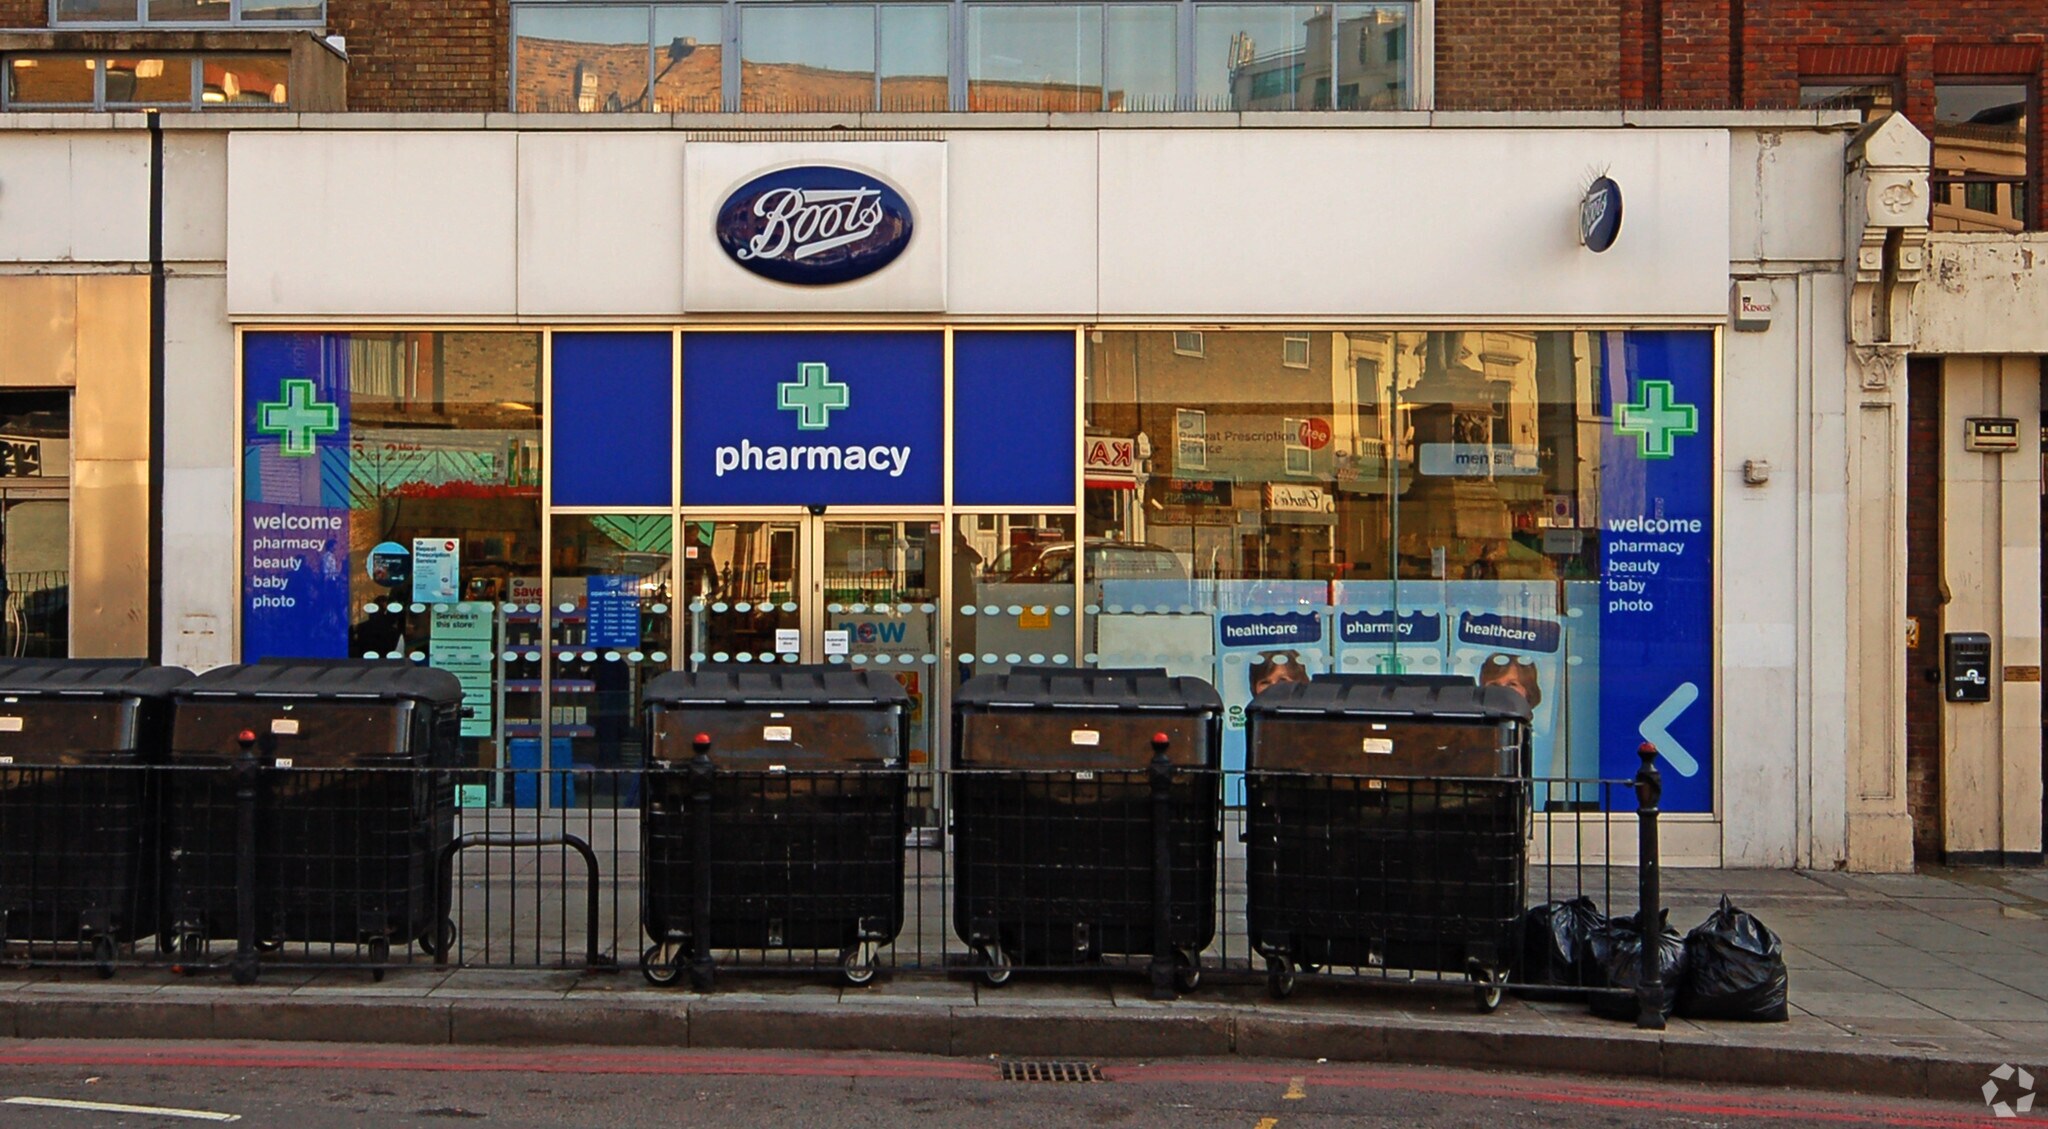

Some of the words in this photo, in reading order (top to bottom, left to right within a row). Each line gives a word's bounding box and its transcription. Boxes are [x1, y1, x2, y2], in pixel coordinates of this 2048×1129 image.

[737, 187, 883, 260] Boots
[1225, 431, 1296, 443] Prescription
[1300, 424, 1327, 442] free
[715, 439, 911, 477] pharmacy
[252, 512, 342, 530] welcome
[1608, 514, 1702, 533] welcome
[253, 536, 326, 552] pharmacy
[1609, 539, 1685, 555] pharmacy
[253, 555, 302, 572] beauty
[1609, 558, 1660, 575] beauty
[253, 575, 289, 591] baby
[1609, 578, 1646, 594] baby
[513, 587, 543, 597] save
[253, 594, 296, 610] photo
[1609, 598, 1654, 614] photo
[838, 621, 907, 644] new
[1226, 622, 1299, 638] healthcare
[1464, 621, 1537, 642] healthcare
